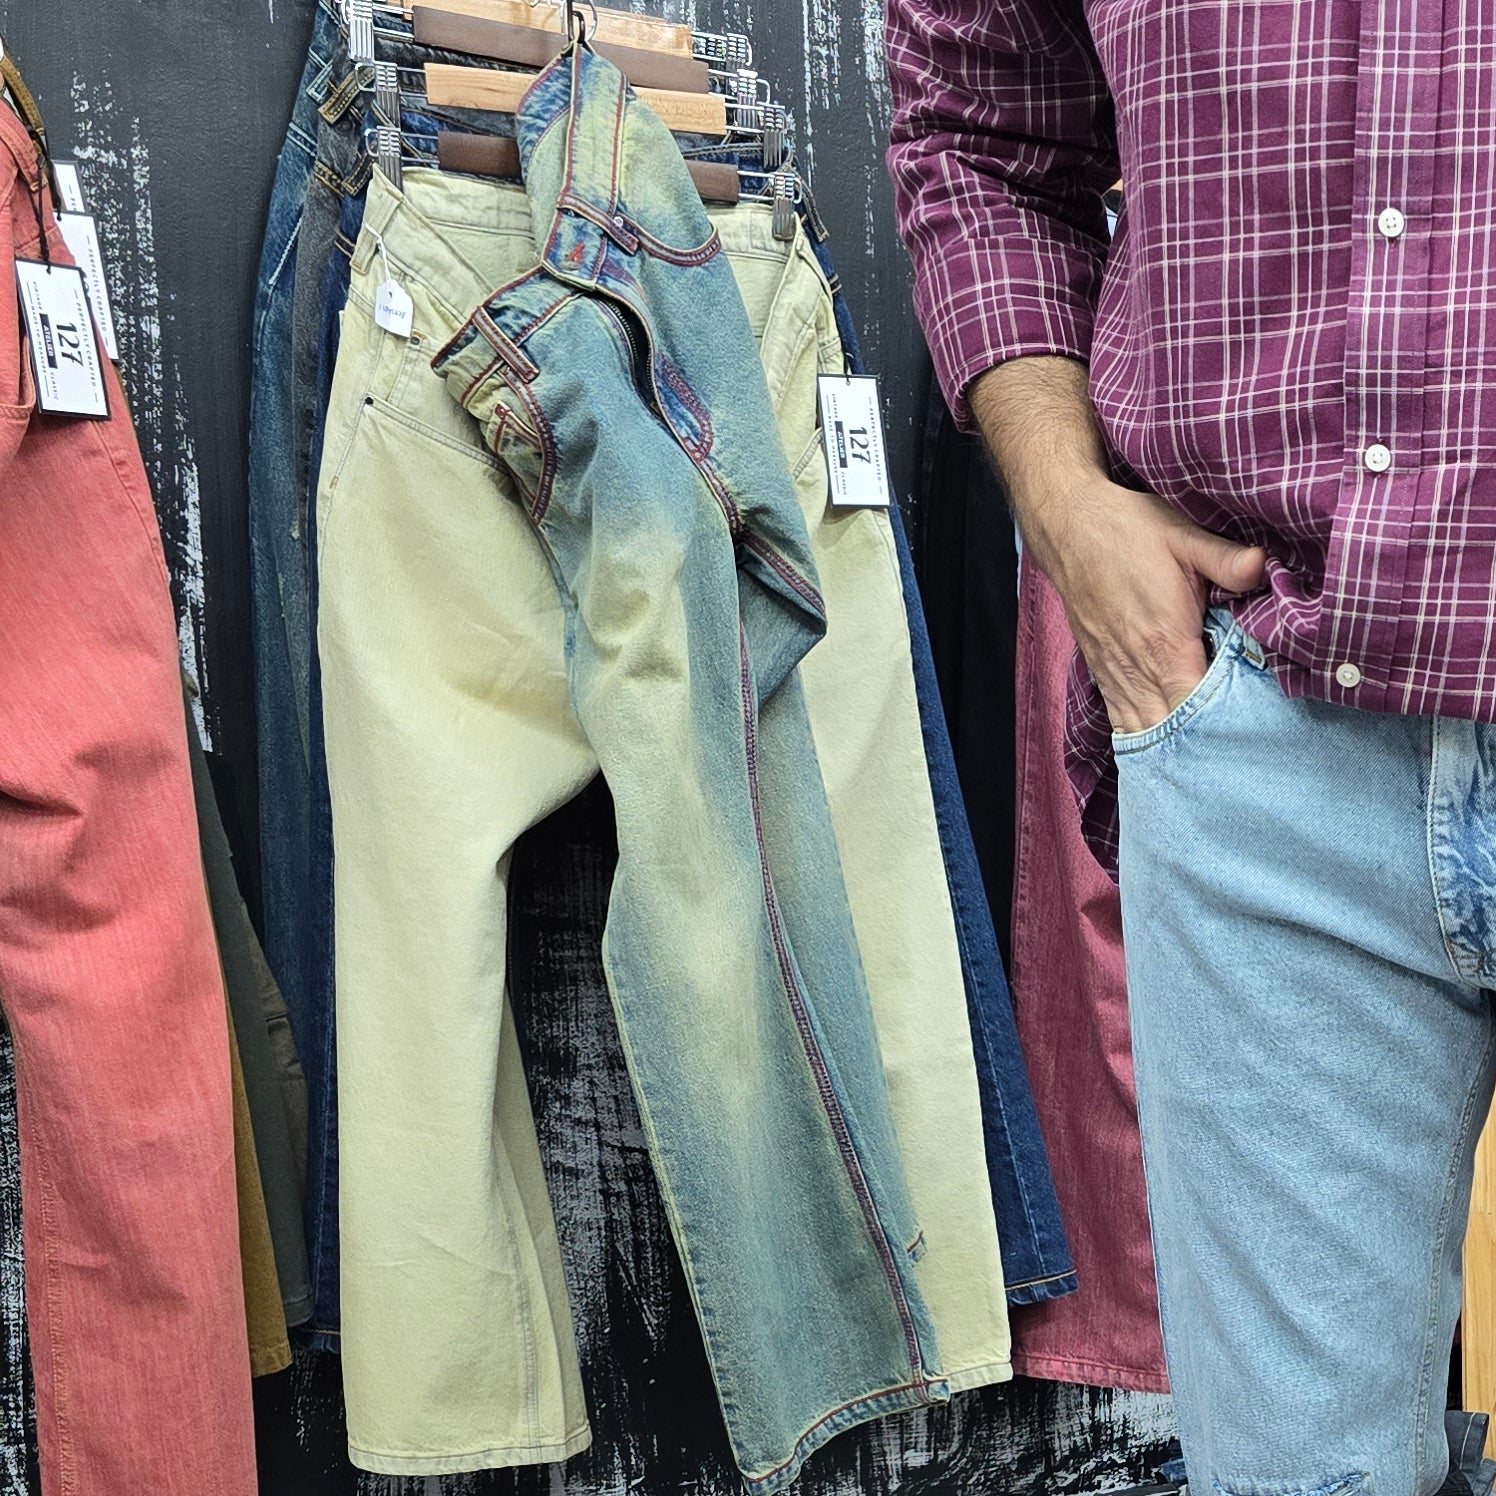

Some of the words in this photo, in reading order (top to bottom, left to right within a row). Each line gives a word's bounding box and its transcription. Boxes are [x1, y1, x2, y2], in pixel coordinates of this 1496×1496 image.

[87, 248, 101, 294] PERFECTLY
[96, 295, 107, 333] CRAFTED
[43, 325, 54, 357] ATELIER
[56, 322, 84, 367] 127
[75, 303, 89, 349] PERFECTLY
[86, 350, 97, 388] CRAFTED
[837, 431, 845, 458] ATELIER
[849, 426, 871, 465] 127
